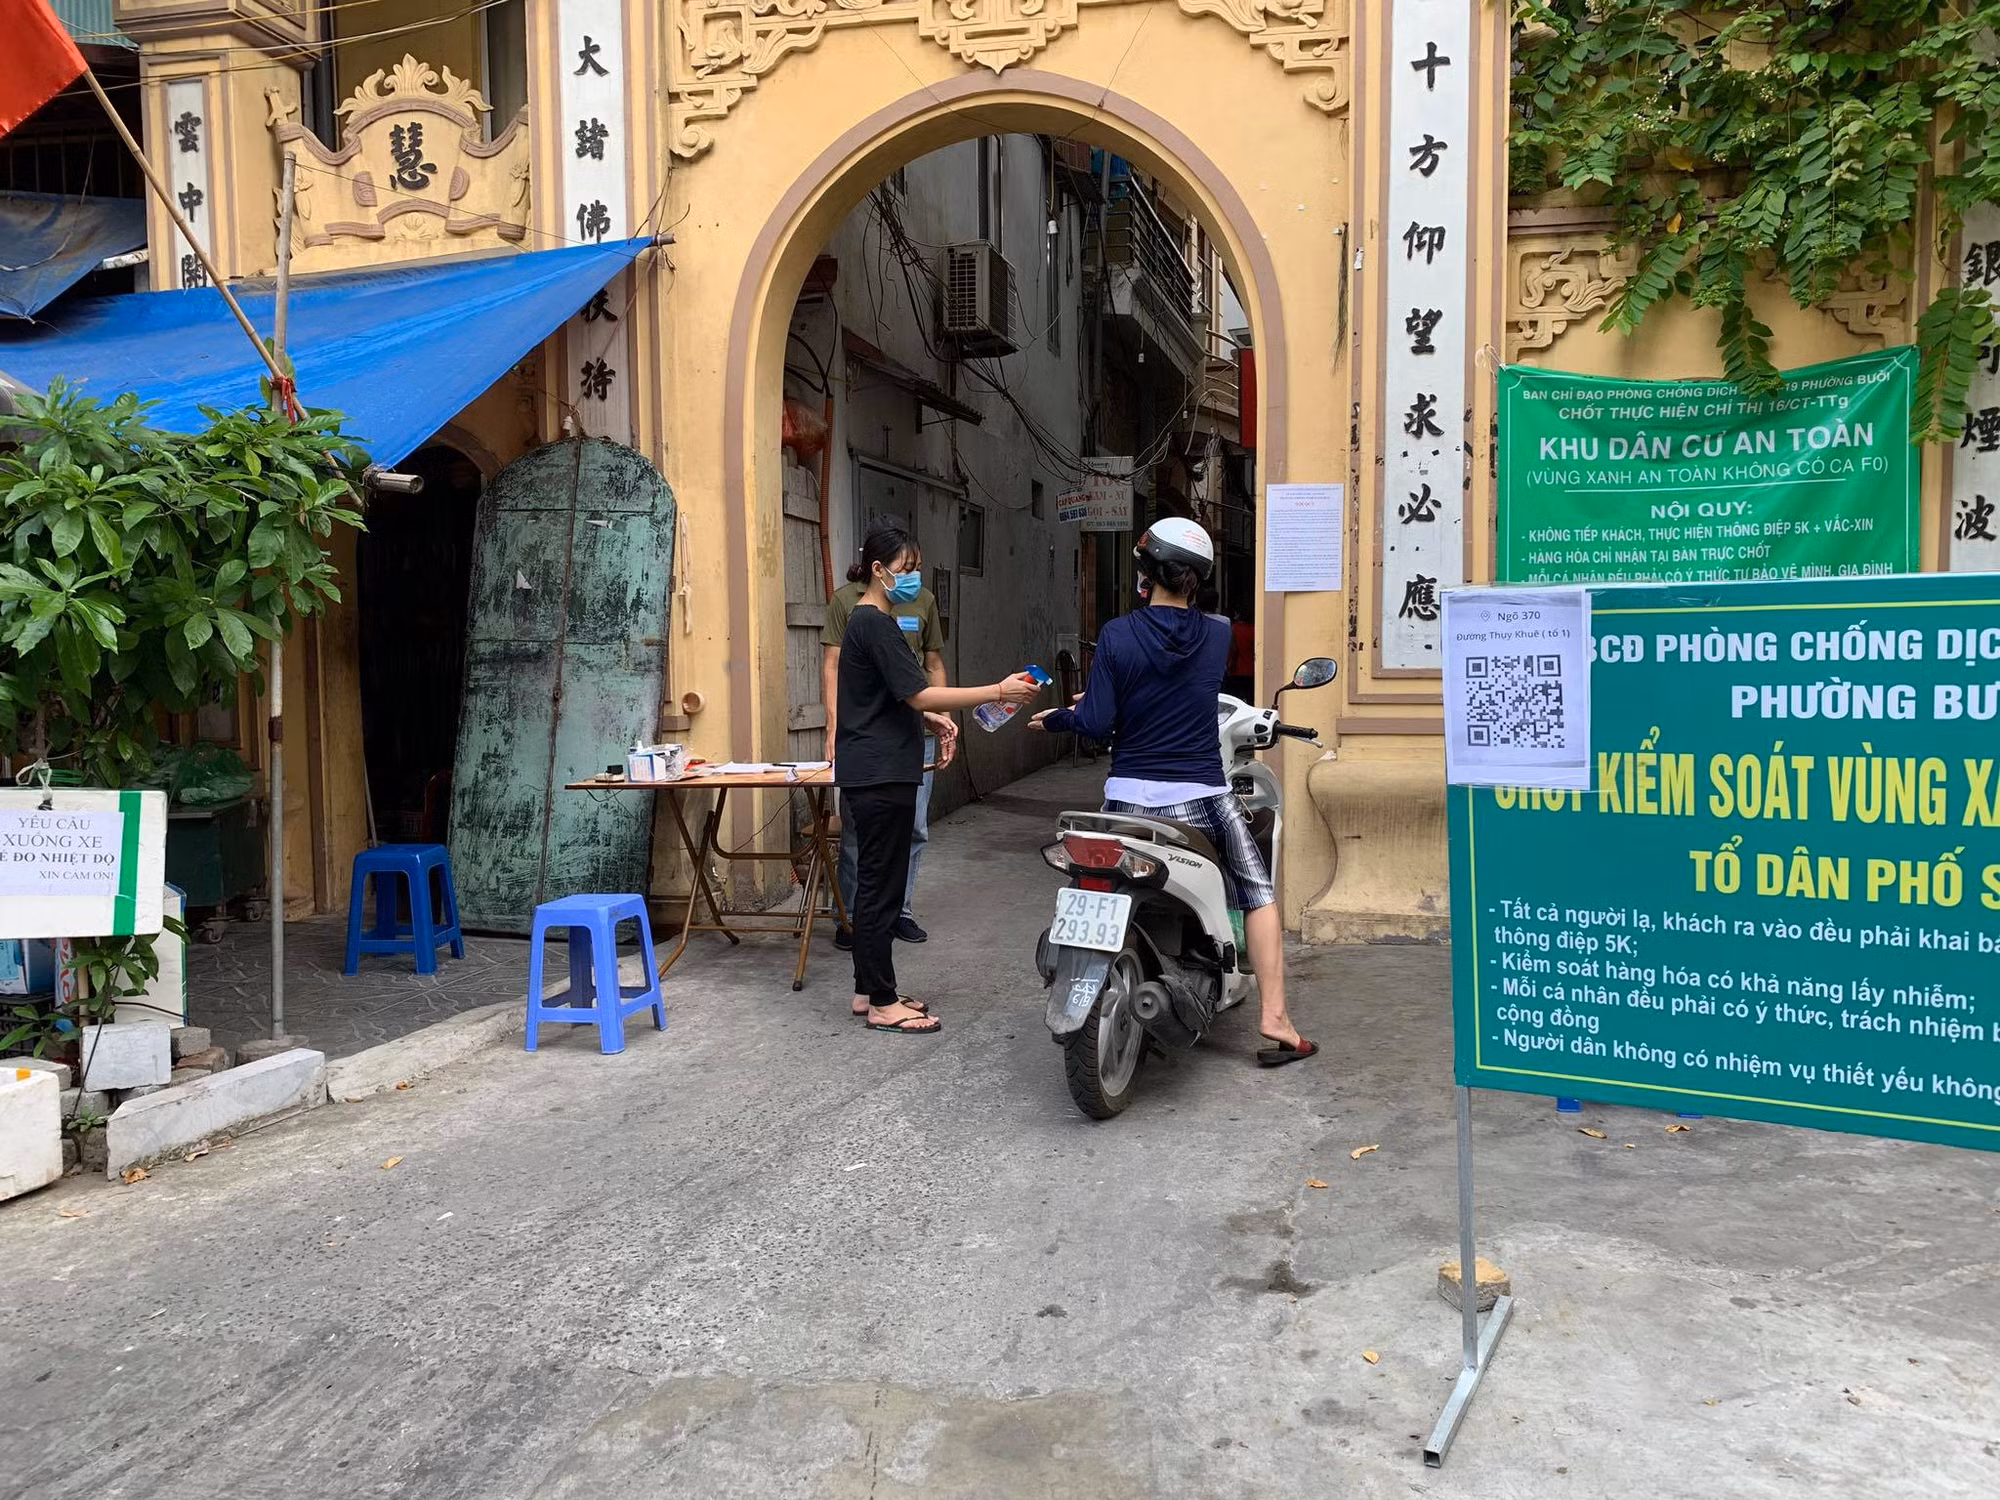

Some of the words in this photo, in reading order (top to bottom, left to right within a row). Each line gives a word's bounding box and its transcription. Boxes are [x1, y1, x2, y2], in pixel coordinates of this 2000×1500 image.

[389, 121, 437, 191] 慧
[1399, 40, 1452, 621] 十方仰望求必應
[1523, 390, 1547, 400] BAN
[1551, 387, 1574, 400] CHỈ
[1576, 390, 1604, 402] ĐẠO
[1607, 386, 1652, 400] PHÒNG
[1656, 384, 1703, 399] CHỐNG
[1707, 386, 1738, 398] DỊCH
[1801, 377, 1853, 391] PHƯỜNG
[1857, 370, 1891, 385] BƯỞI
[1558, 403, 1604, 420] CHỐT
[1610, 404, 1654, 421] THỰC
[1659, 402, 1699, 420] HIỆN
[1704, 399, 1732, 416] CHỈ
[1737, 401, 1763, 416] THỊ
[1769, 394, 1849, 413] 16/CT-TTg
[1539, 437, 1599, 461] KHU
[1608, 431, 1672, 460] DÂN
[1681, 430, 1727, 458] CƯ
[1733, 430, 1776, 455] AN
[1786, 418, 1874, 452] TOÀN
[1526, 467, 1580, 488] (VÙNG
[1586, 470, 1632, 485] XANH
[1637, 469, 1662, 485] AN
[1668, 464, 1717, 483] TOÀN
[1723, 461, 1791, 480] KHÔNG
[1797, 455, 1826, 475] CÓ
[1830, 458, 1855, 474] CA
[1651, 500, 1690, 521] NỘI
[1698, 501, 1753, 517] QUY:
[1529, 526, 1571, 542] KHÔNG
[1574, 524, 1598, 542] TIẾP
[1601, 525, 1646, 543] KHÁCH,
[1648, 526, 1681, 543] THỰC
[1684, 523, 1712, 541] HIỆN
[1716, 521, 1760, 538] THÔNG
[1763, 518, 1791, 538] ĐIỆP
[1794, 521, 1810, 535] 5K
[1813, 524, 1821, 533] +
[1824, 513, 1874, 533] VẮC-XIN
[1529, 548, 1562, 565] HÀNG
[1566, 548, 1590, 564] HÓA
[1592, 546, 1612, 564] CHỈ
[1615, 547, 1647, 565] NHẬN
[1650, 550, 1669, 565] TẠI
[1672, 546, 1697, 563] BÀN
[1702, 546, 1734, 562] TRỰC
[1738, 540, 1771, 559] CHỐT
[1838, 563, 1859, 577] GIA
[1862, 560, 1893, 576] ĐÌNH
[1522, 611, 1541, 620] 370
[1656, 626, 1777, 662] PHÒNG
[1790, 619, 1923, 661] CHỐNG
[1731, 677, 1916, 719] PHƯỜNG
[1598, 726, 1695, 816] KIỂM
[1709, 741, 1815, 820] SOÁT
[1827, 742, 1947, 826] VÙNG
[18, 814, 51, 829] YÊU
[56, 815, 91, 830] CẦU
[3, 831, 72, 848] XUỐNG
[78, 835, 103, 848] XE
[40, 851, 88, 866] NHIỆT
[93, 852, 115, 866] ĐỘ
[1167, 853, 1203, 868] VISION
[1689, 835, 1743, 894] TỔ
[1757, 846, 1849, 900] DÂN
[1867, 846, 1966, 907] PHỐ
[39, 870, 59, 879] XIN
[1065, 893, 1118, 921] 29-F1
[1055, 917, 1120, 947] 293.93
[1500, 897, 1531, 920] Tất
[1536, 903, 1559, 922] cả
[1565, 907, 1626, 928] người
[1633, 909, 1656, 933] lạ,
[1663, 911, 1727, 934] khách
[1734, 920, 1754, 936] ra
[1762, 918, 1802, 939] vào
[1809, 917, 1852, 943] đều
[1860, 925, 1910, 949] phải
[1919, 928, 1970, 951] khai
[1494, 926, 1550, 952] thông
[1556, 930, 1599, 955] điệp
[1605, 934, 1638, 958] 5K;
[1502, 949, 1550, 973] Kiểm
[1556, 958, 1600, 978] soát
[1605, 961, 1656, 987] hàng
[1662, 965, 1701, 986] hóa
[1707, 970, 1734, 989] có
[1740, 971, 1780, 994] khả
[1787, 976, 1843, 1004] năng
[1851, 977, 1885, 1007] lấy
[1893, 984, 1975, 1014] nhiễm;
[1496, 1003, 1544, 1028] cộng
[1550, 1005, 1600, 1034] đồng
[1503, 976, 1537, 998] Mỗi
[1543, 982, 1565, 1001] cá
[1571, 984, 1620, 1005] nhân
[1627, 986, 1664, 1010] đều
[1671, 994, 1716, 1016] phải
[1722, 999, 1749, 1018] có
[1755, 1001, 1768, 1024] ý
[1775, 1003, 1833, 1030] thức,
[1841, 1009, 1900, 1033] trách
[1909, 1016, 1984, 1043] nhiệm
[1504, 1028, 1564, 1052] Người
[1570, 1036, 1606, 1057] dân
[1613, 1040, 1676, 1069] không
[1683, 1049, 1708, 1068] có
[1716, 1052, 1782, 1078] nhiệm
[1789, 1063, 1816, 1084] vụ
[1823, 1062, 1874, 1087] thiết
[1881, 1066, 1924, 1093] yếu
